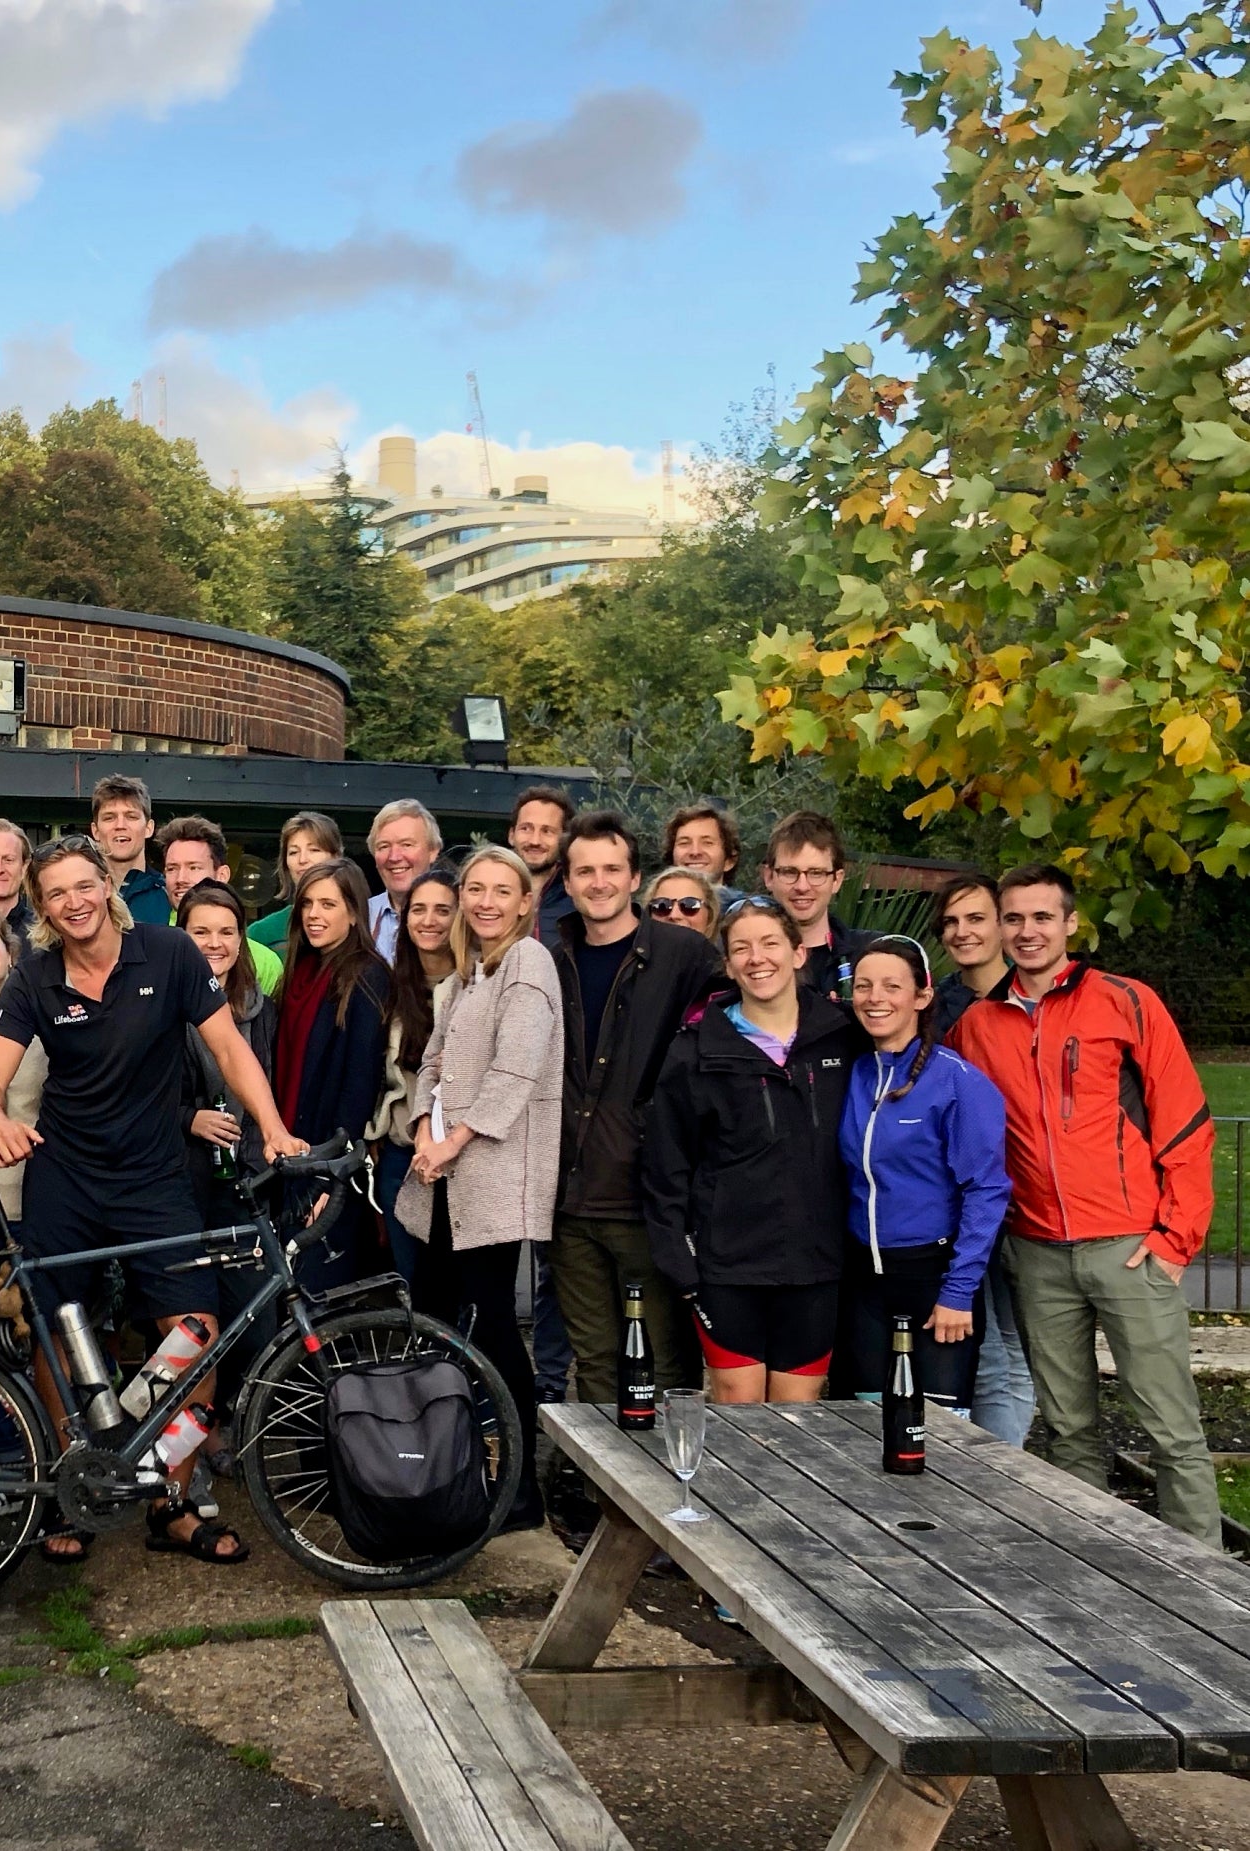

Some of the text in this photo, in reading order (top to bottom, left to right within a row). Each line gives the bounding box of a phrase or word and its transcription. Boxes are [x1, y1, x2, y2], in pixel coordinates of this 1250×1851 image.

[139, 987, 154, 996] HH
[54, 1014, 89, 1025] Lifeboats
[822, 1057, 841, 1067] DLX
